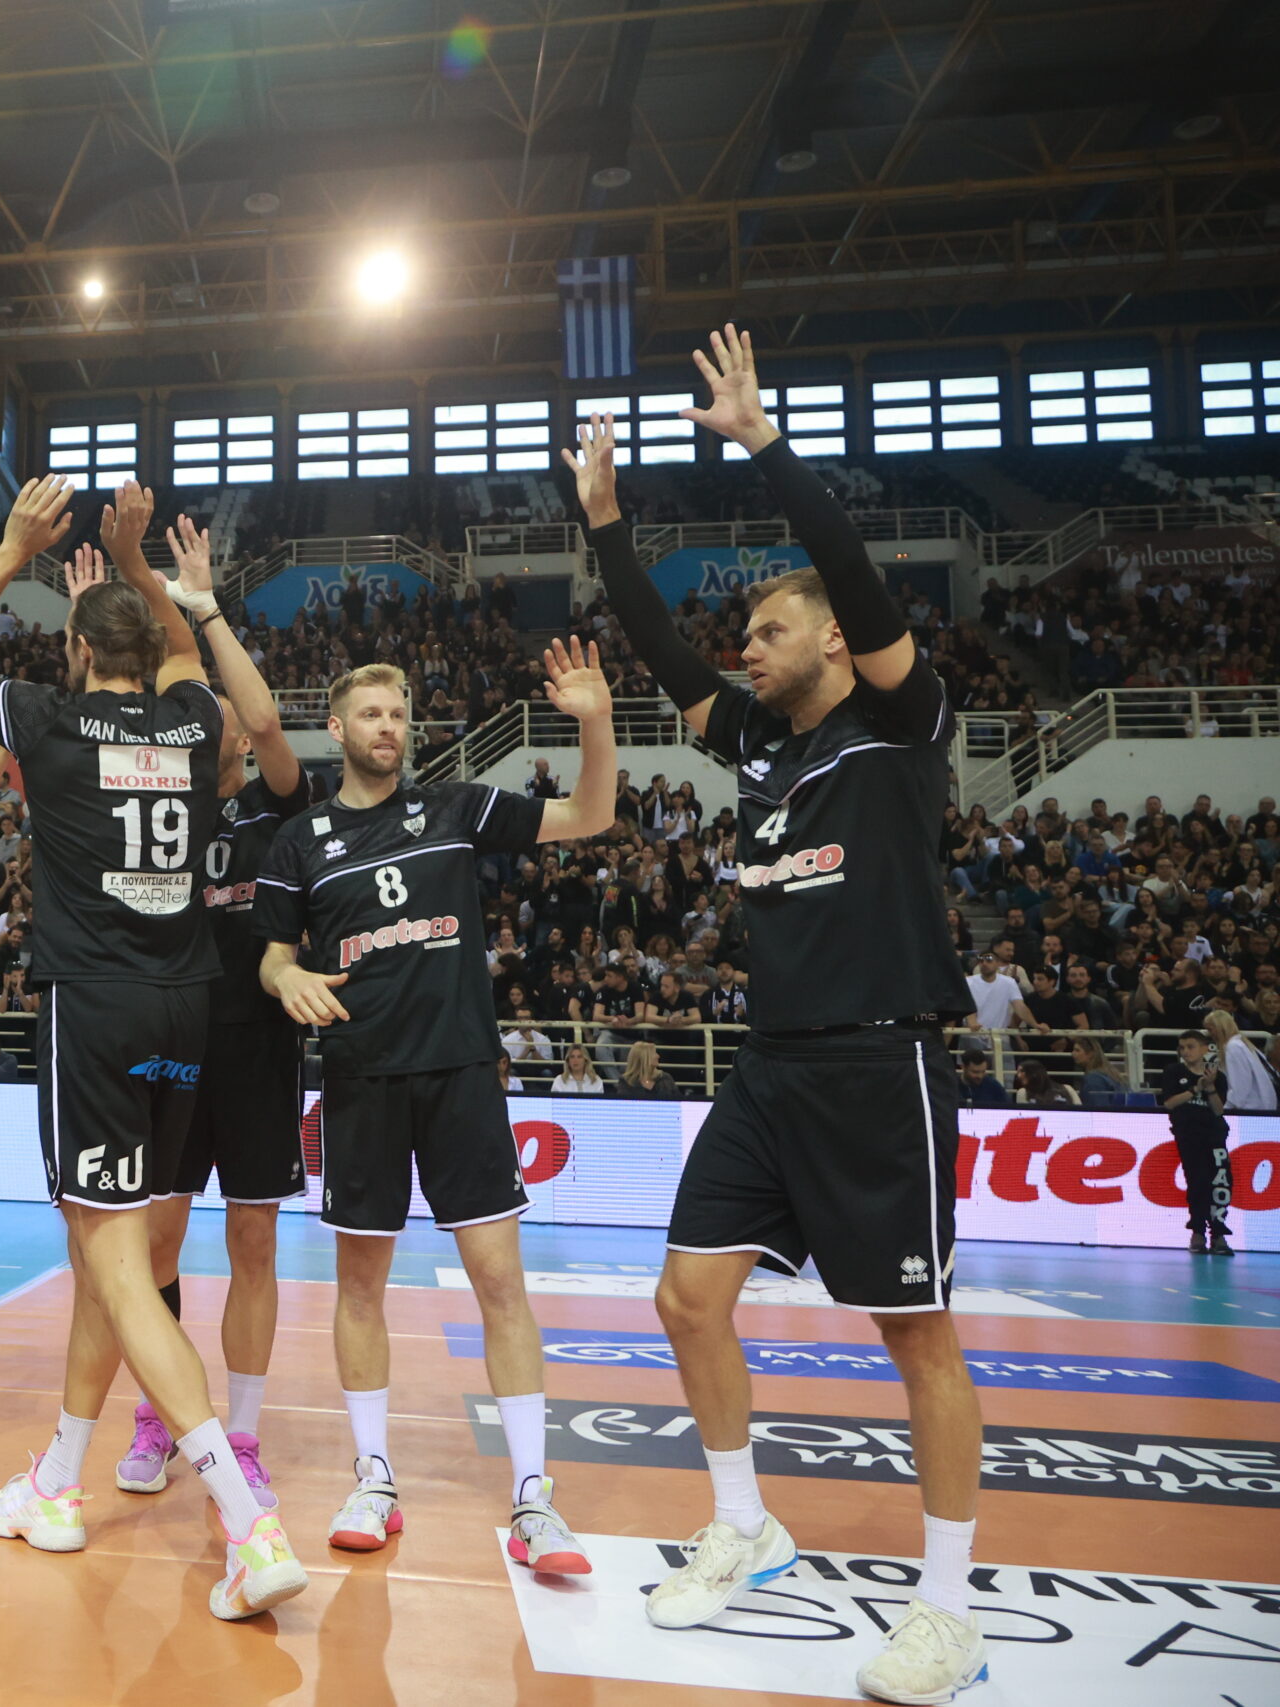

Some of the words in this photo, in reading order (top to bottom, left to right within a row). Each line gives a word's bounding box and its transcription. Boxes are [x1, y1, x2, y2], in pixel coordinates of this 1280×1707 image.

[1097, 543, 1276, 568] Tlementes
[79, 716, 116, 742] VAN
[154, 722, 206, 746] DRIES
[103, 775, 189, 789] MORRIS
[111, 798, 189, 869] 19
[754, 800, 790, 846] 4
[375, 865, 409, 908] 8
[340, 915, 460, 969] mateco
[1210, 1148, 1232, 1223] PAOK
[756, 1349, 1170, 1381] MARTHON
